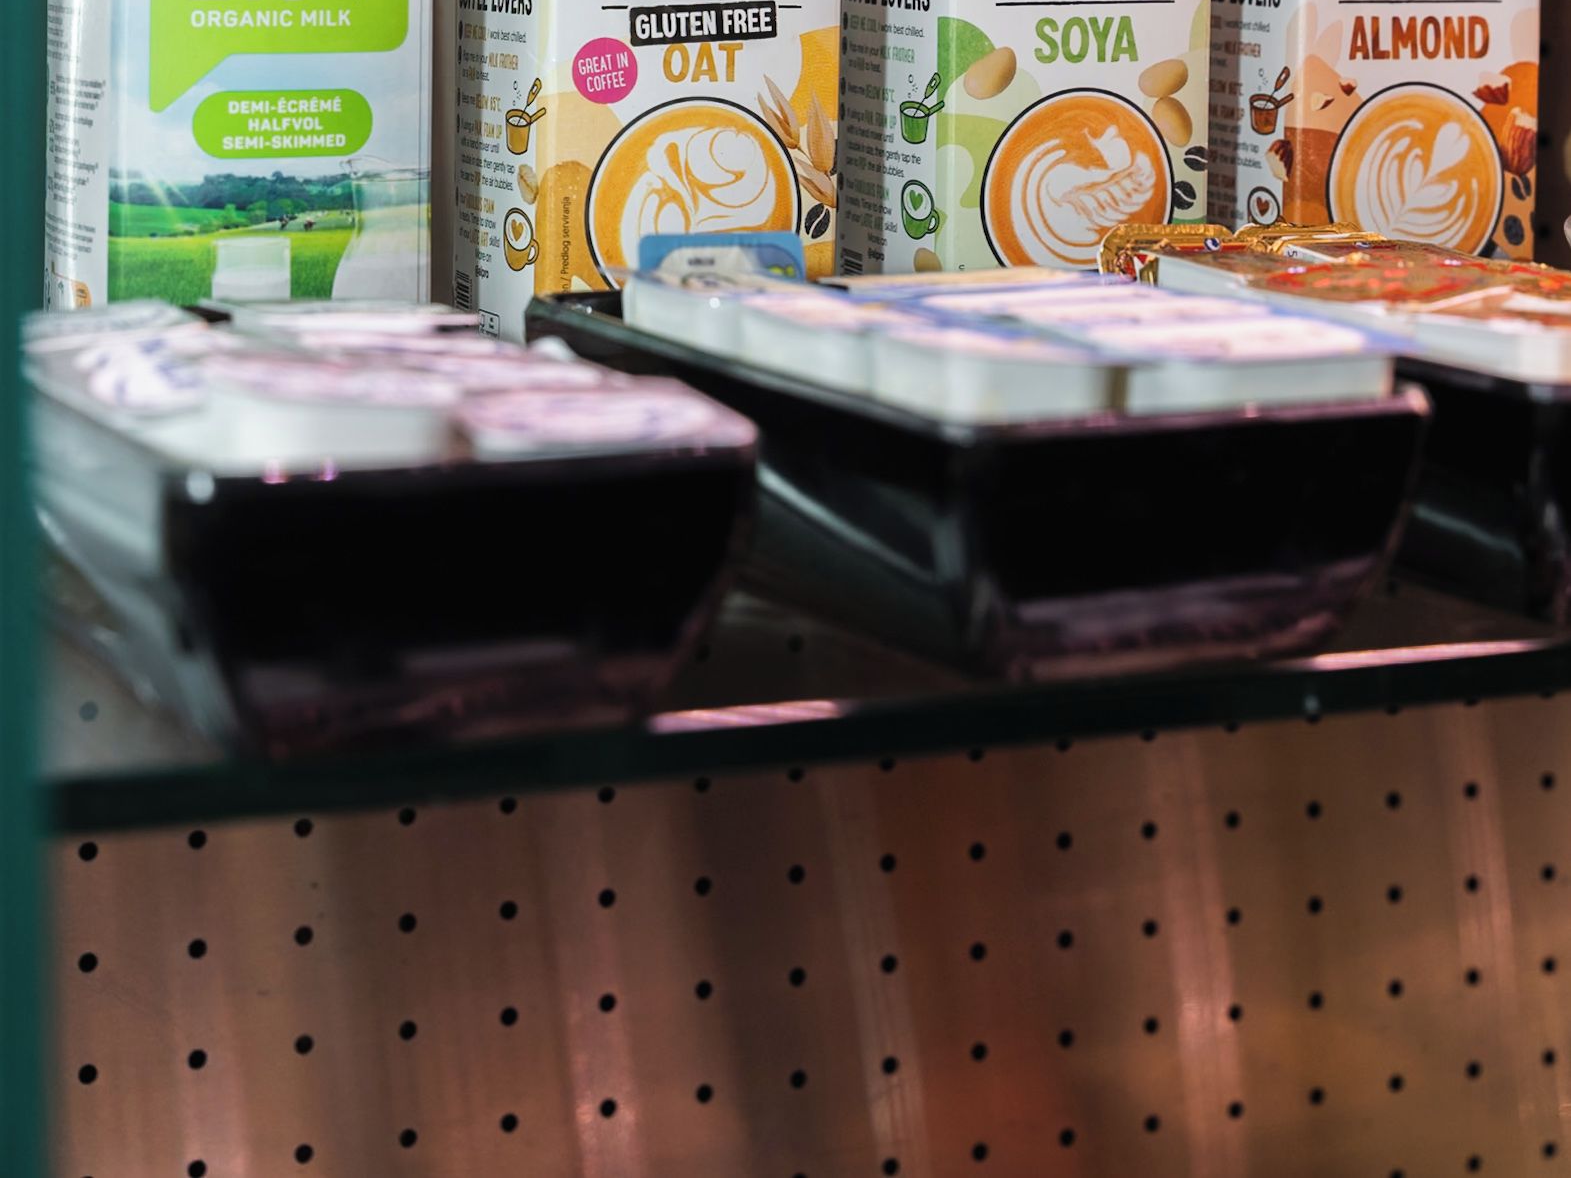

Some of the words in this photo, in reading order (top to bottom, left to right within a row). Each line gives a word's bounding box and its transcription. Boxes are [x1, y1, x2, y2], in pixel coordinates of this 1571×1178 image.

[191, 10, 293, 28] ORGANIC
[301, 9, 352, 27] MILK
[635, 12, 716, 40] GLUTEN
[722, 6, 772, 36] FREE
[500, 30, 510, 41] best
[893, 24, 904, 34] best
[905, 26, 925, 38] chilled.
[1034, 16, 1138, 63] SOYA
[1349, 16, 1490, 60] ALMOND
[578, 54, 612, 75] GREAT
[617, 52, 629, 70] IN
[663, 43, 744, 83] OAT
[587, 70, 626, 92] COFFEE
[248, 116, 323, 132] HALFVOL
[222, 134, 346, 150] SEMI-SKIMMED
[886, 150, 900, 162] gently
[902, 152, 910, 163] tap
[912, 153, 921, 165] the
[562, 197, 571, 238] serviranja
[561, 240, 571, 274] Predlog
